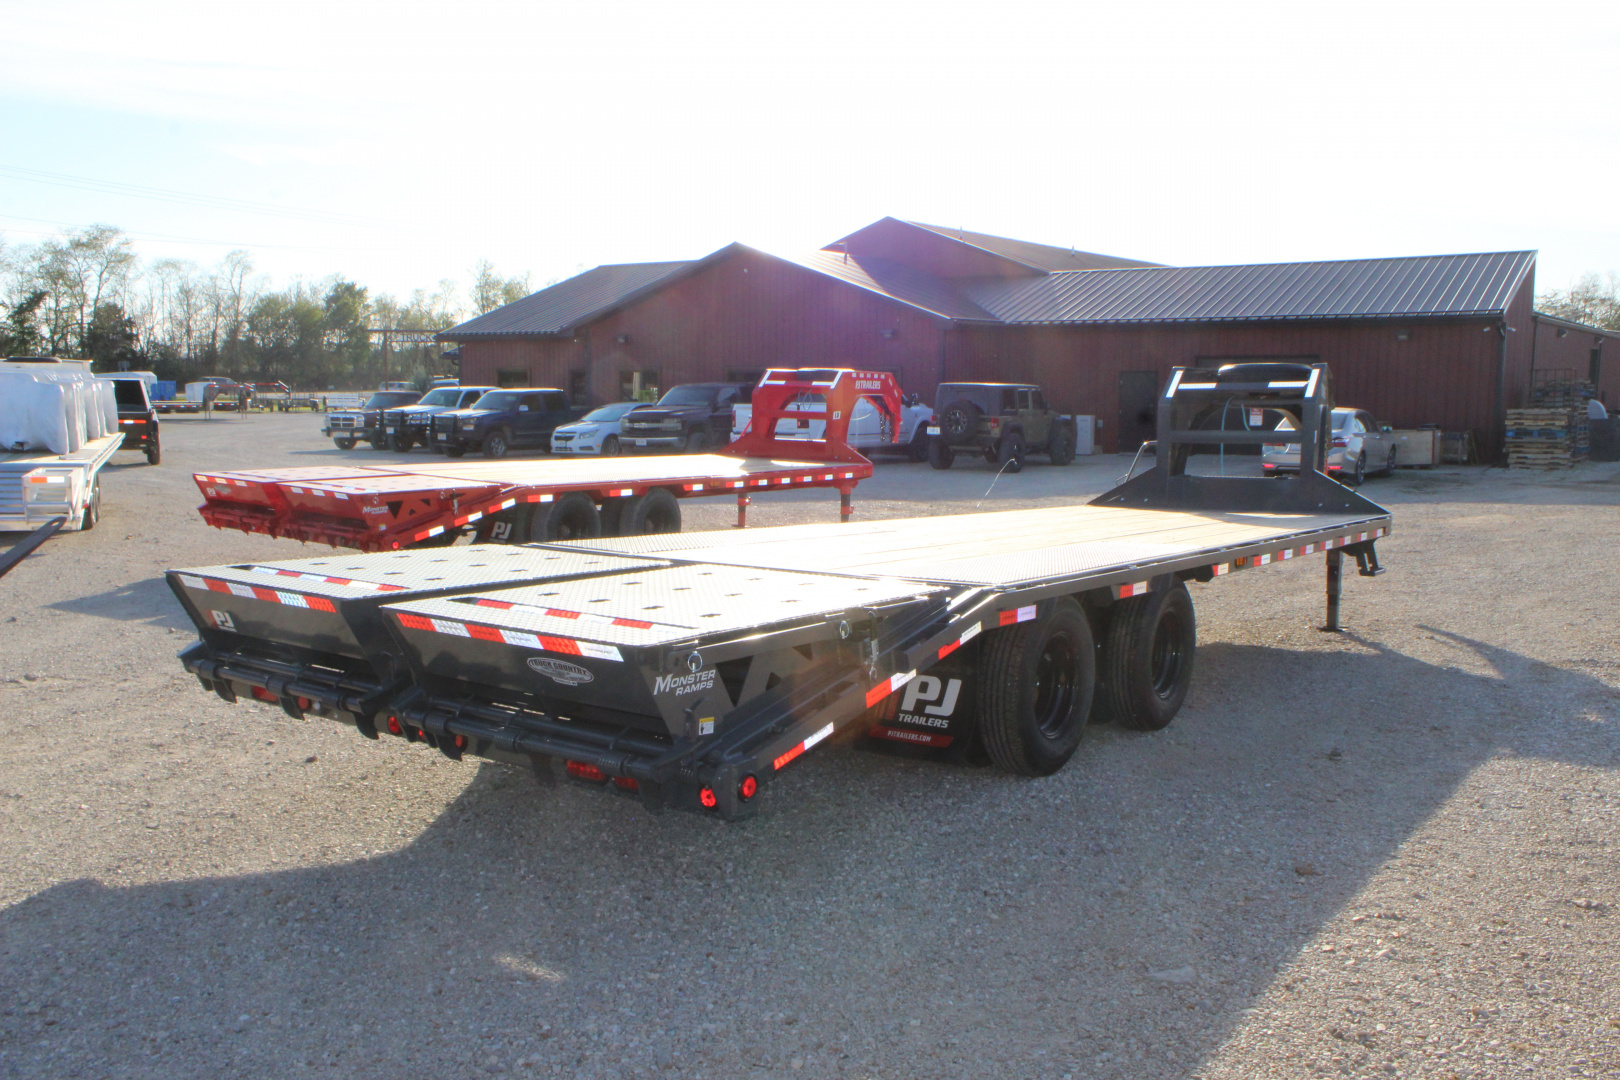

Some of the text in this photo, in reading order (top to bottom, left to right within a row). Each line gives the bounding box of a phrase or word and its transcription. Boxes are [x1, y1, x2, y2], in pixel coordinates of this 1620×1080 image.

[402, 333, 436, 342] TRUCK
[491, 521, 512, 539] PJ
[211, 609, 235, 628] PJ
[653, 669, 716, 696] MONSTER
[675, 680, 714, 696] RAMPS
[901, 674, 962, 717] PJ
[898, 713, 949, 729] TRAILERS
[887, 730, 932, 742] PJTRAILERS.COM
